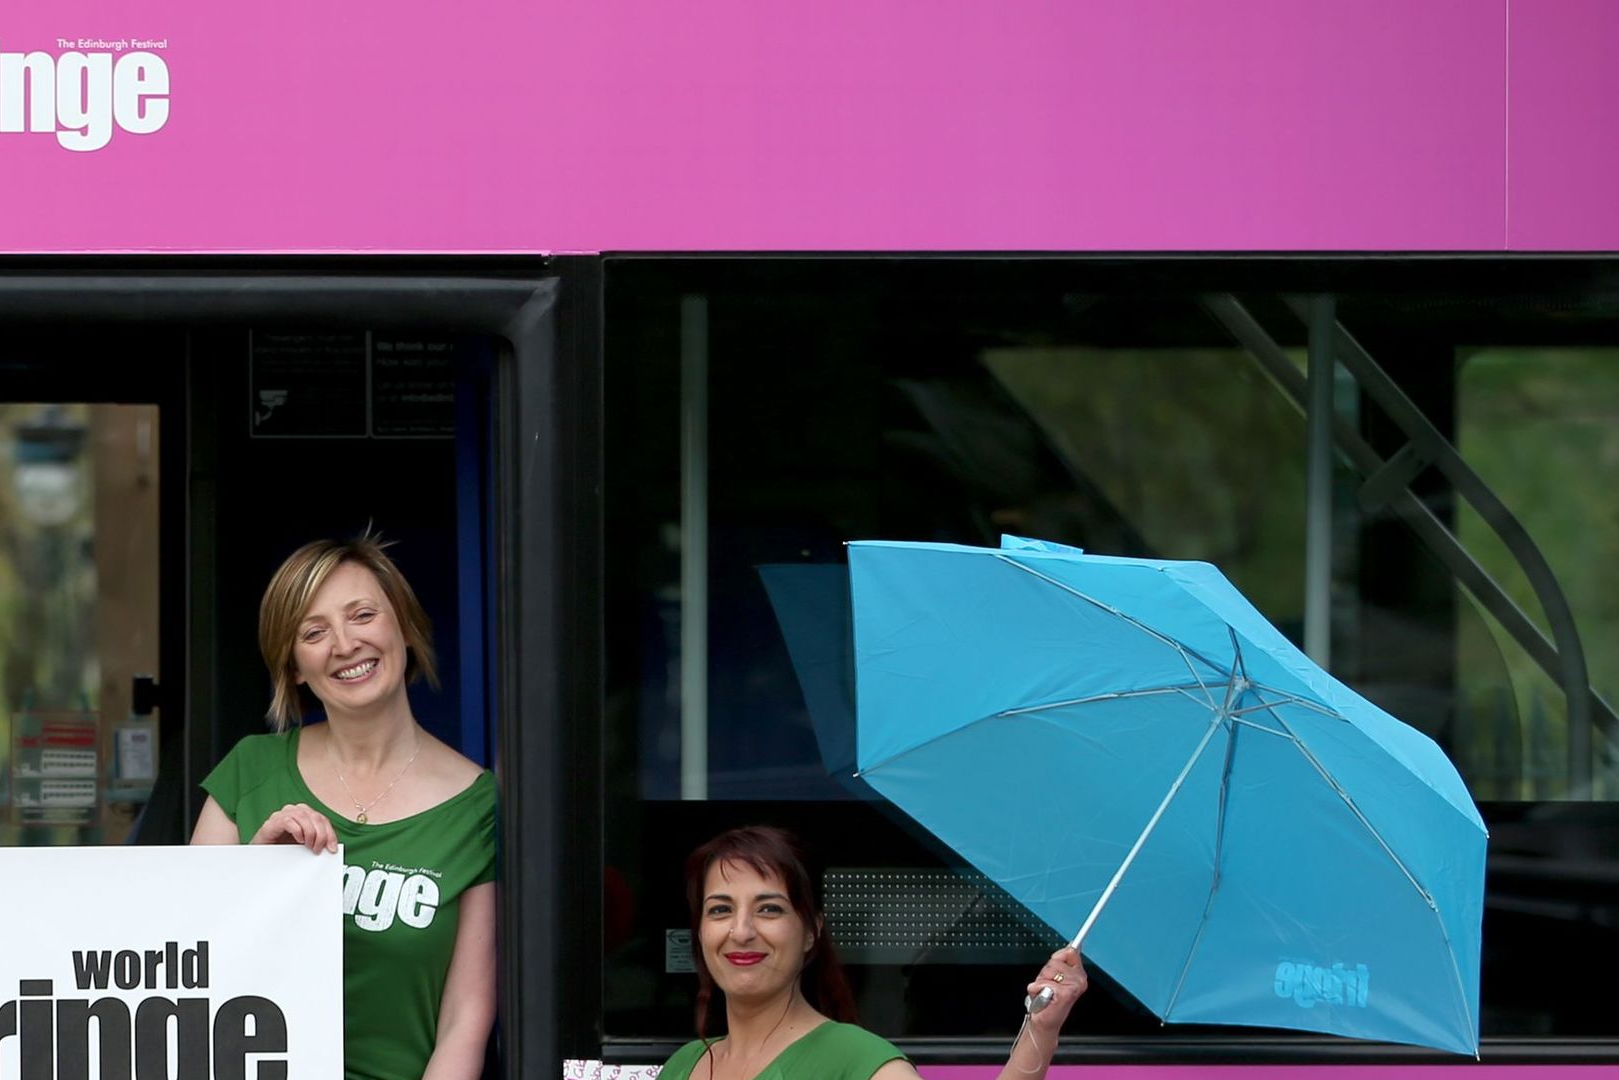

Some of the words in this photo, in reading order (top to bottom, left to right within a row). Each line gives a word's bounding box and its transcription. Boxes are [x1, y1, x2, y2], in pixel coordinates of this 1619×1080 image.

[56, 39, 75, 49] The
[78, 38, 128, 51] Edinburgh
[131, 38, 168, 49] Festival
[372, 861, 384, 869] The
[385, 864, 418, 874] Edinburgh
[419, 868, 442, 878] Festival
[343, 865, 439, 931] nge
[72, 941, 209, 990] world
